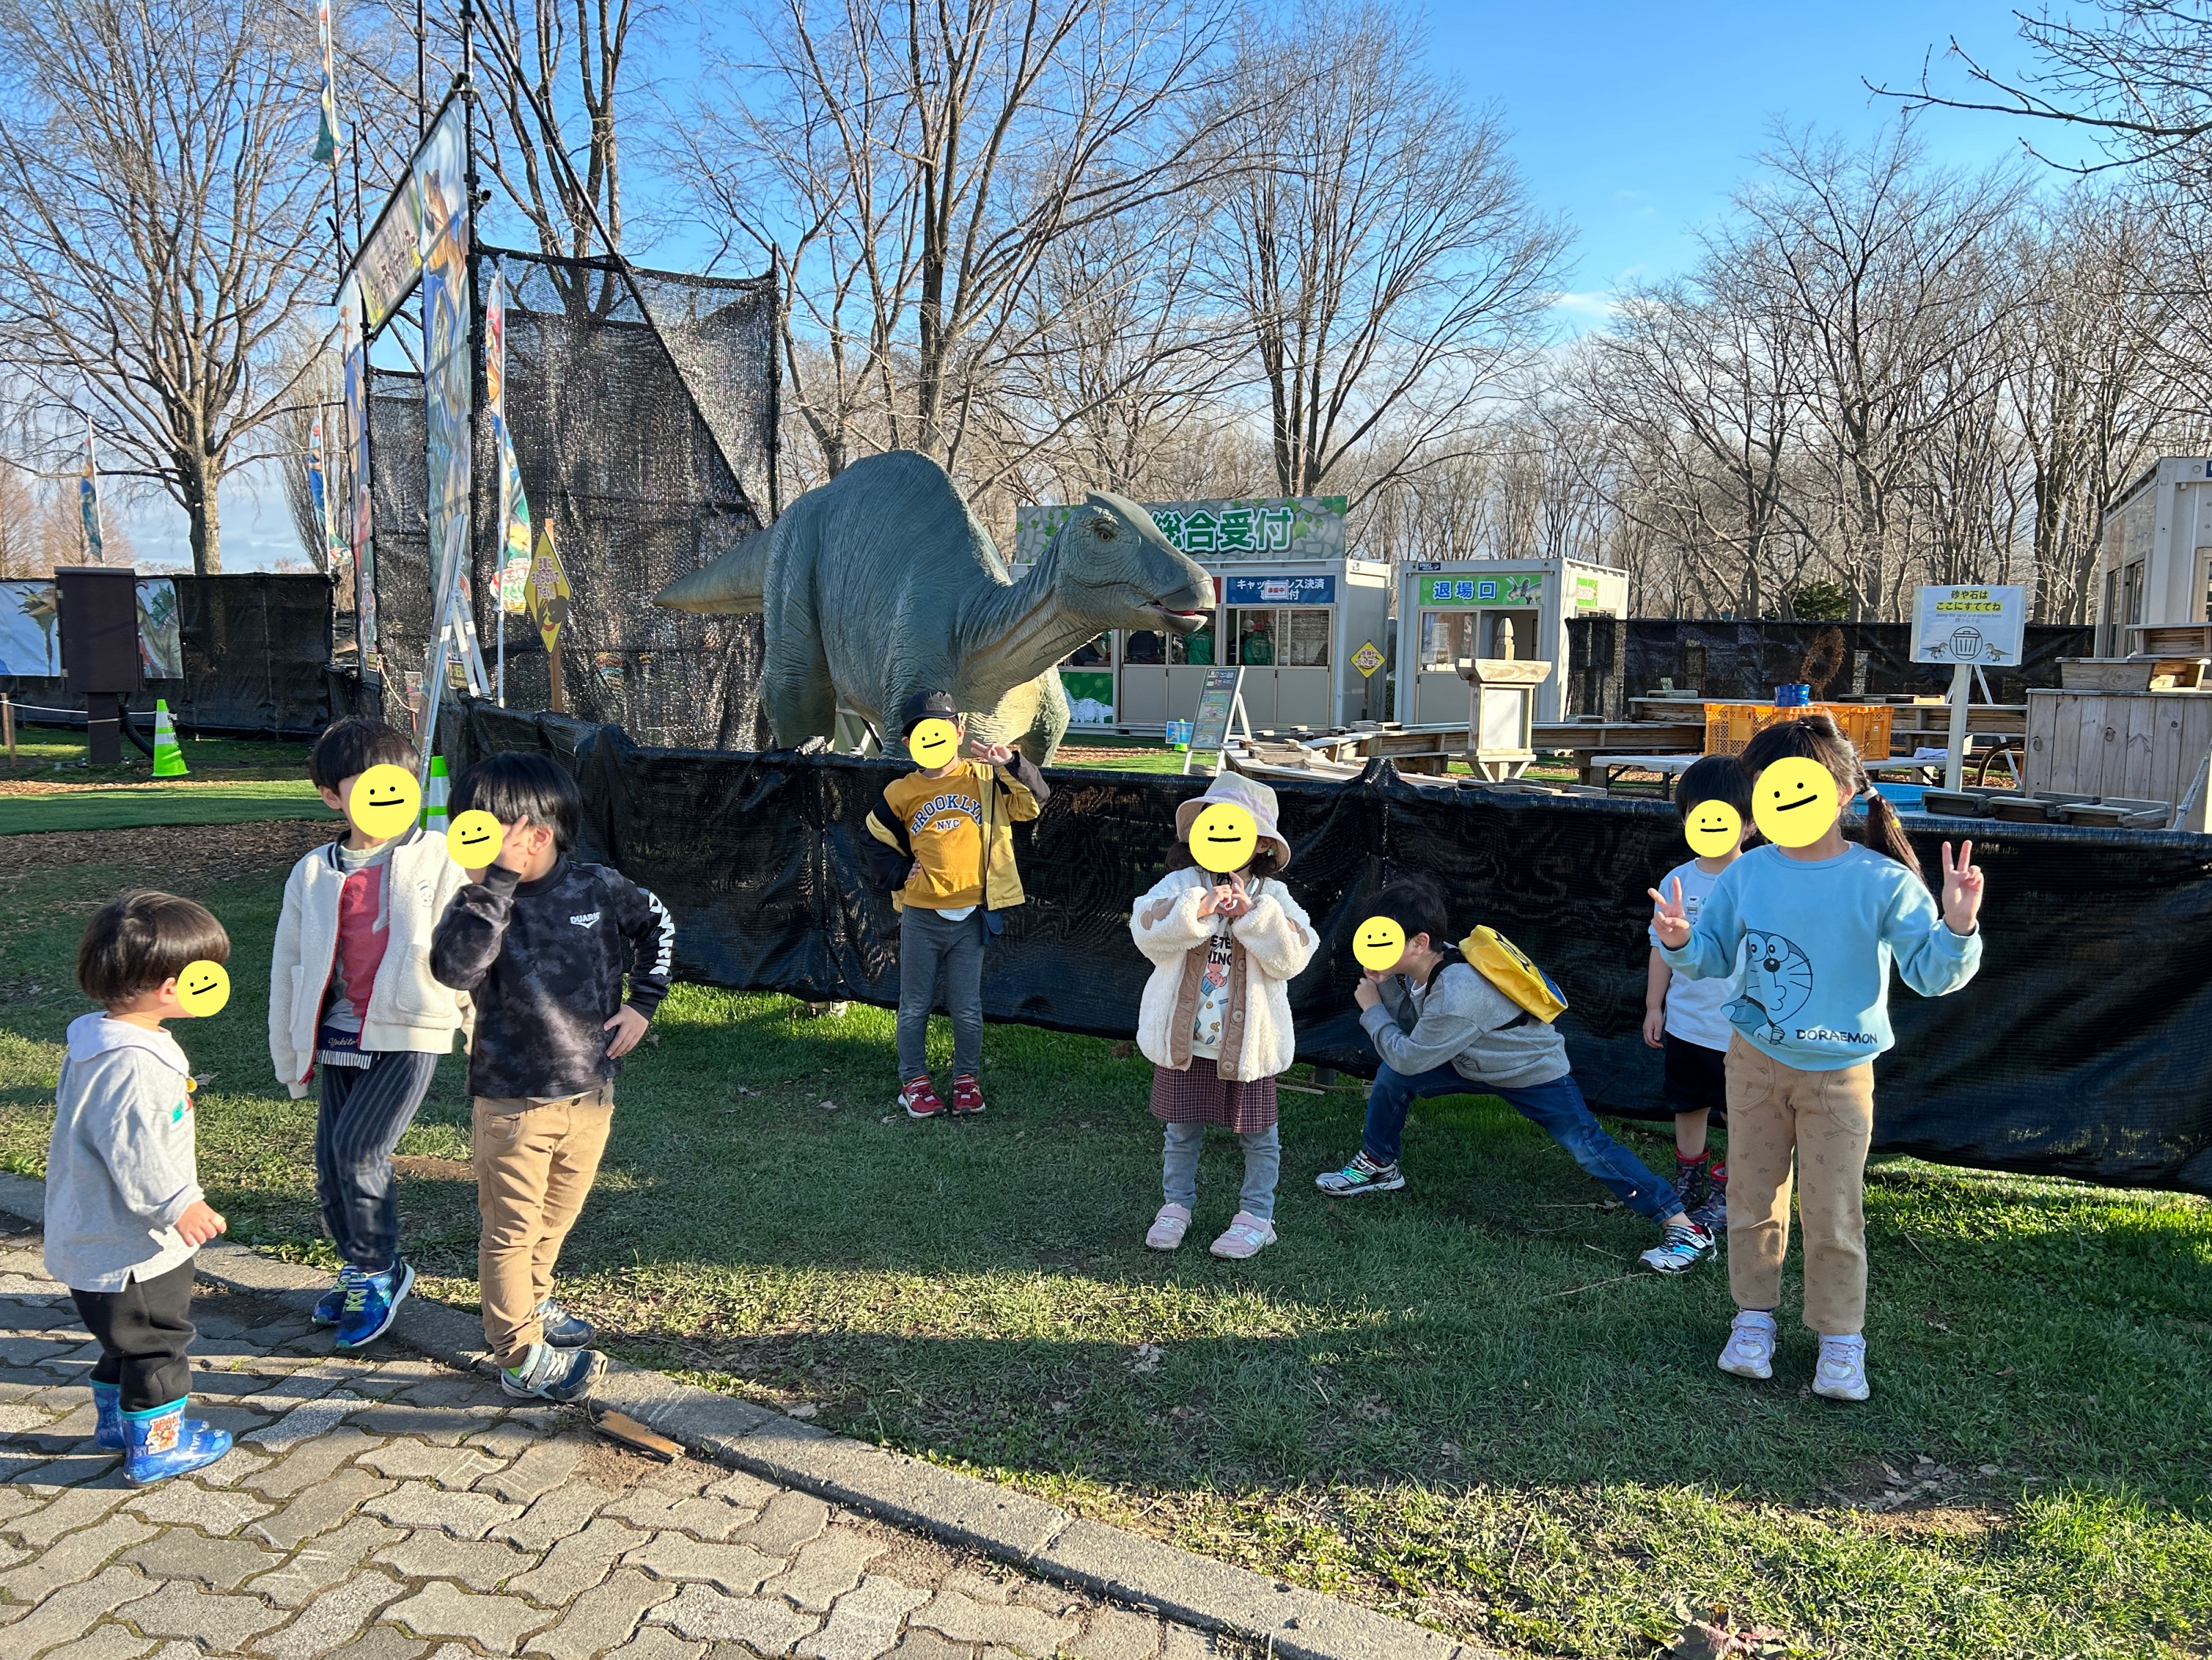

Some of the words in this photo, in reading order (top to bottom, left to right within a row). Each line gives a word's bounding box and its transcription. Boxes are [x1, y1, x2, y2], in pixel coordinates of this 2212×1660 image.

[1433, 581, 1496, 600] 退場口
[1951, 590, 1988, 599] 砂や石は
[1936, 602, 2001, 612] ここにすててね
[936, 818, 960, 831] NYC
[1795, 1029, 1878, 1044] DORAEMON
